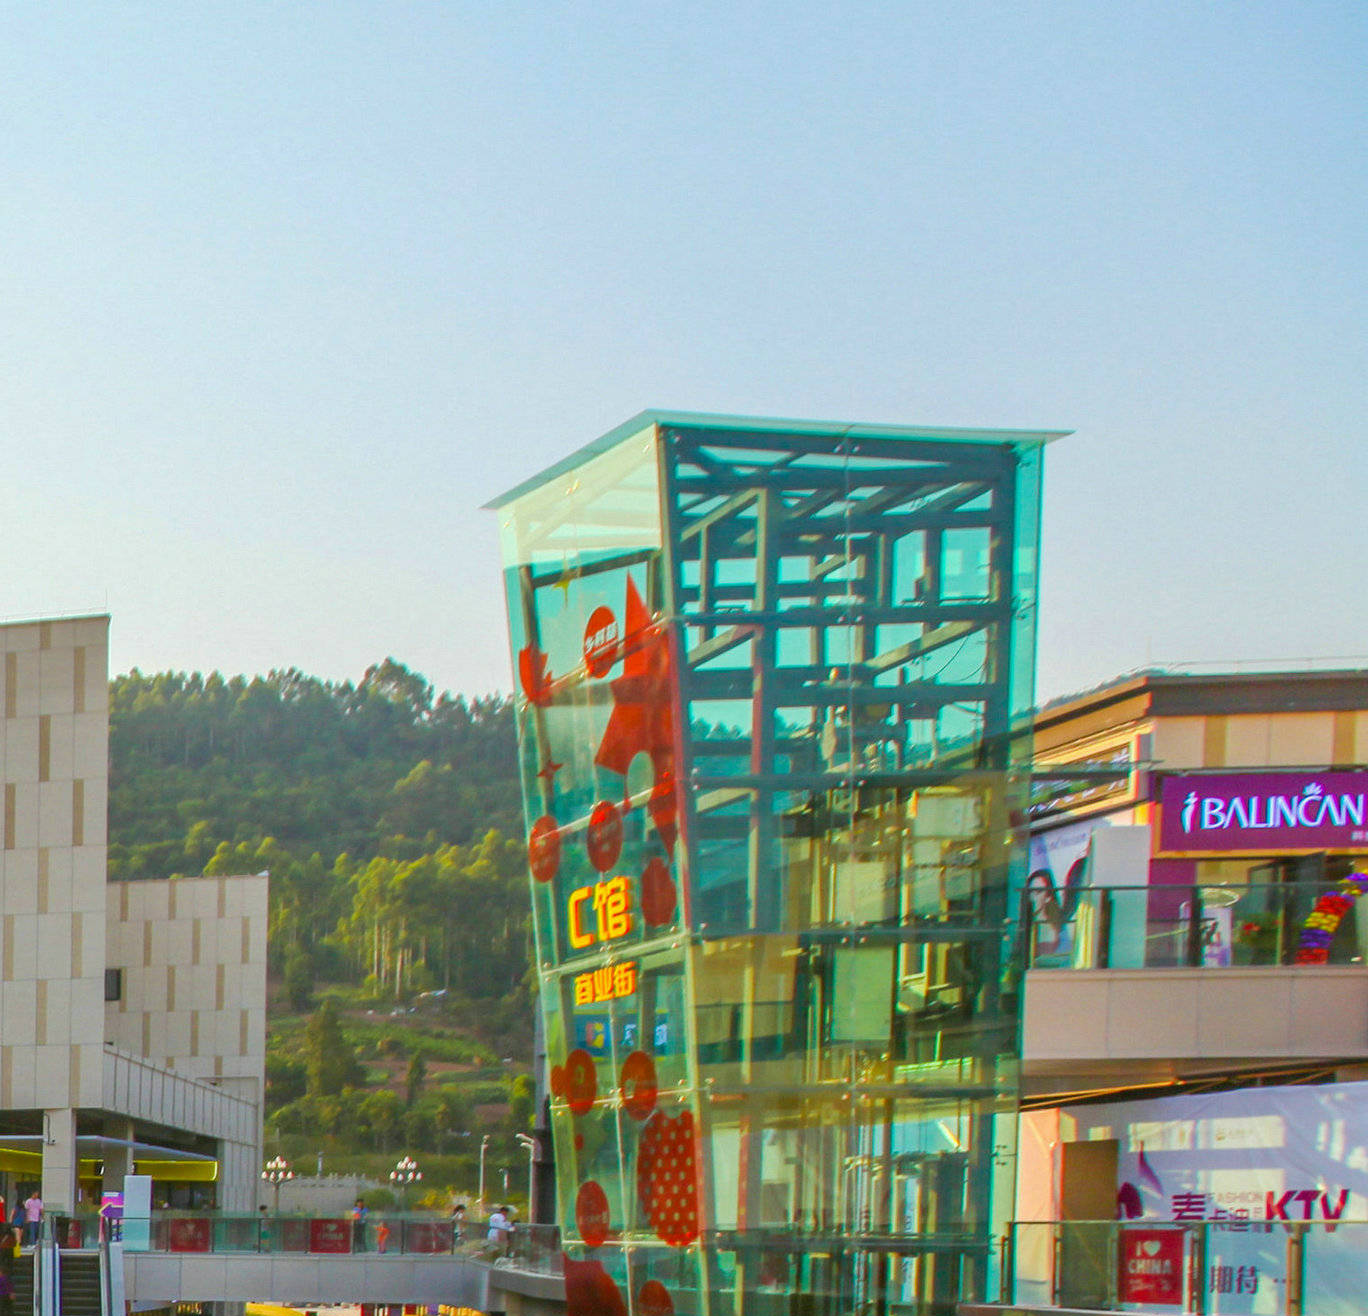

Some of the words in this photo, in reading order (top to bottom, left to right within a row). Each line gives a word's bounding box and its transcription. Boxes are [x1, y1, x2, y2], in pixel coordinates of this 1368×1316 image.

[569, 875, 633, 949] C馆
[1266, 1189, 1350, 1233] KTV
[1128, 1259, 1172, 1274] CHINA
[1209, 1265, 1259, 1294] 期待
